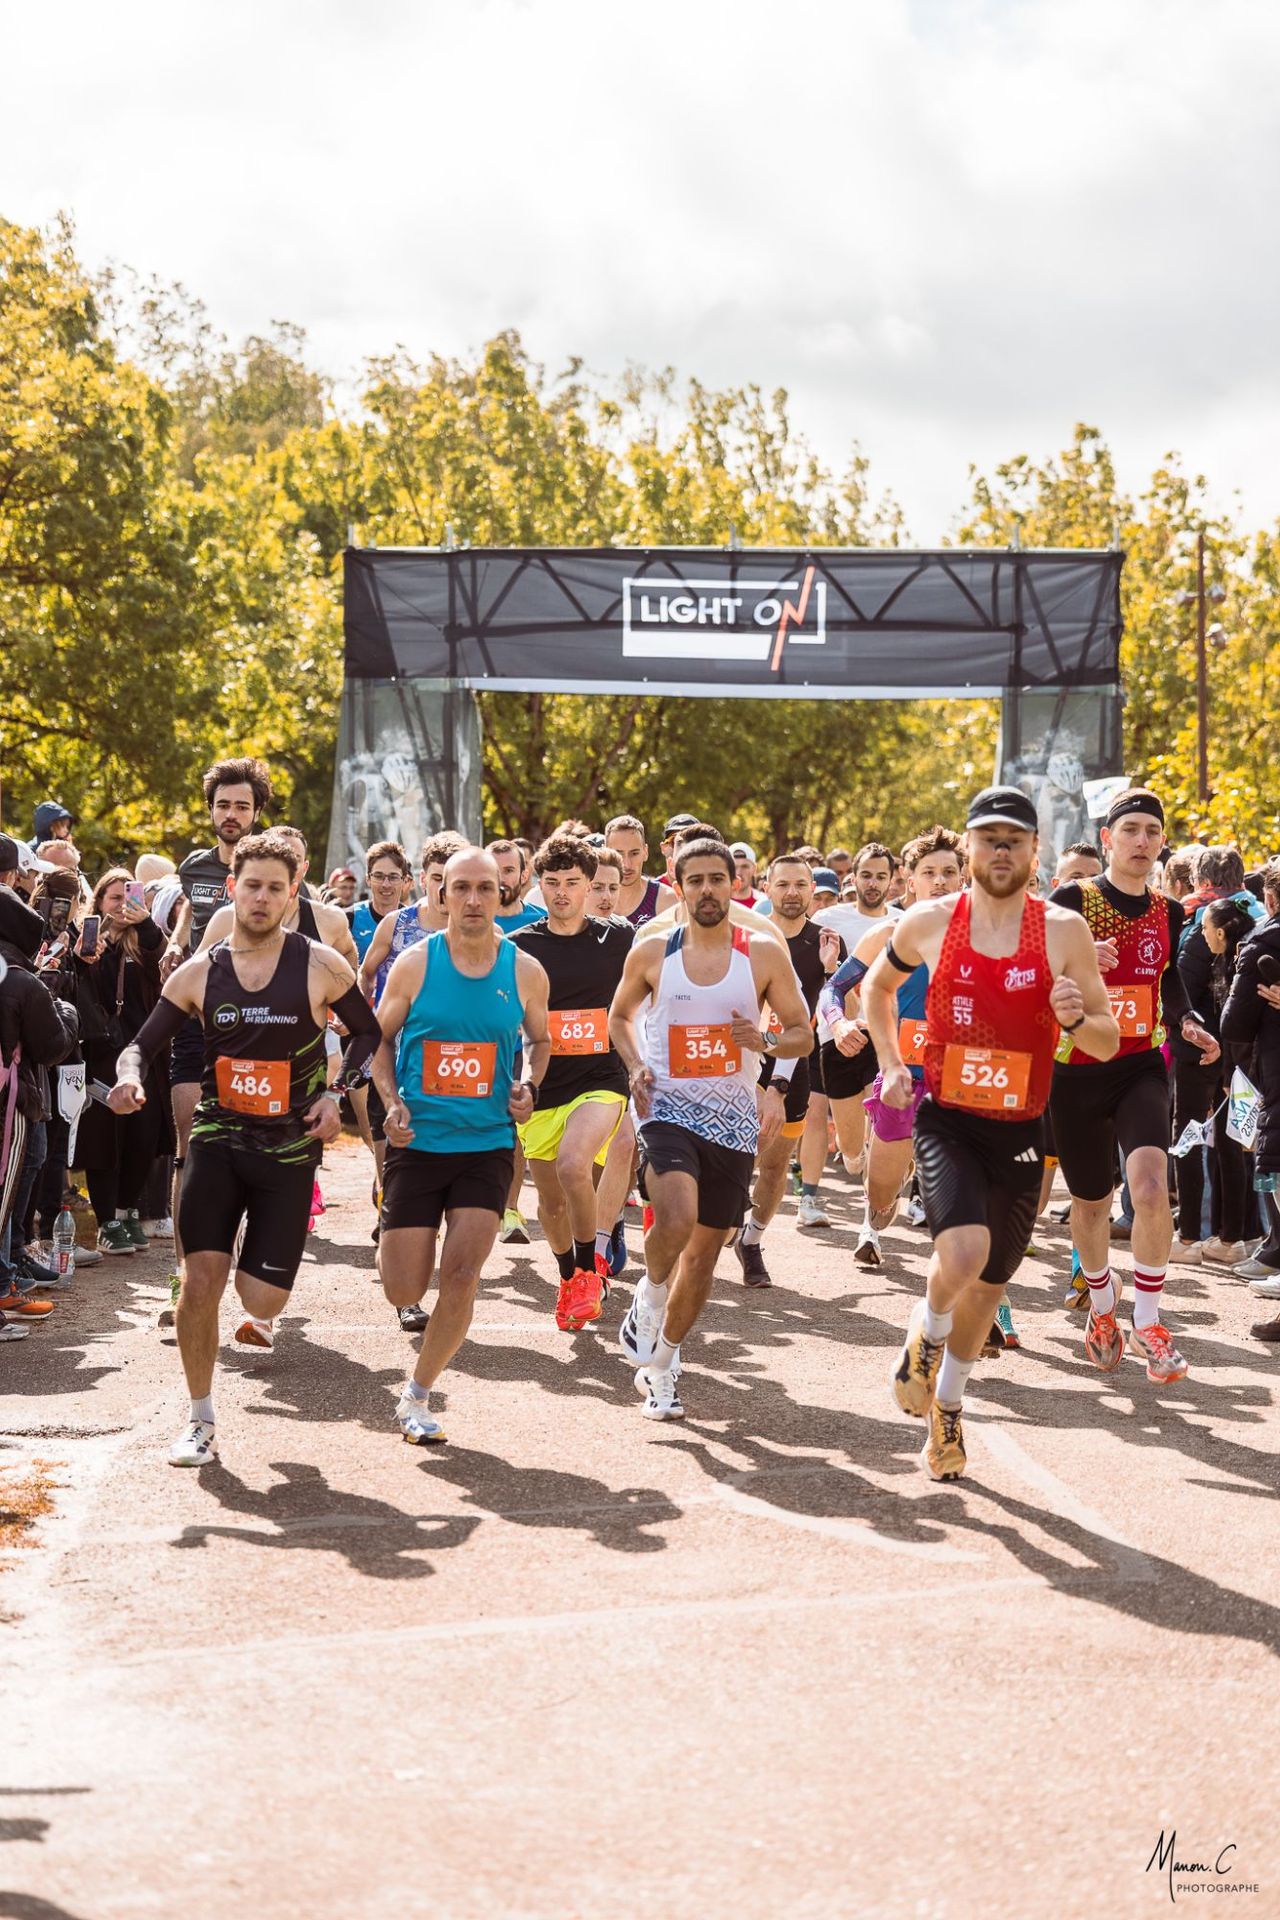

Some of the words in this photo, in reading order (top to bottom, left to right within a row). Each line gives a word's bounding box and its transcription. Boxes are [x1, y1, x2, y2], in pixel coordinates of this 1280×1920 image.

[641, 596, 743, 624] LIGHT
[217, 1013, 236, 1024] TDR
[241, 1007, 270, 1017] TERRE
[953, 1006, 972, 1026] 55
[1109, 1000, 1137, 1019] 73
[254, 1015, 299, 1025] RUNNING
[560, 1022, 596, 1039] 682
[685, 1039, 727, 1059] 354
[437, 1057, 481, 1078] 690
[960, 1063, 1009, 1089] 526
[230, 1074, 272, 1097] 486
